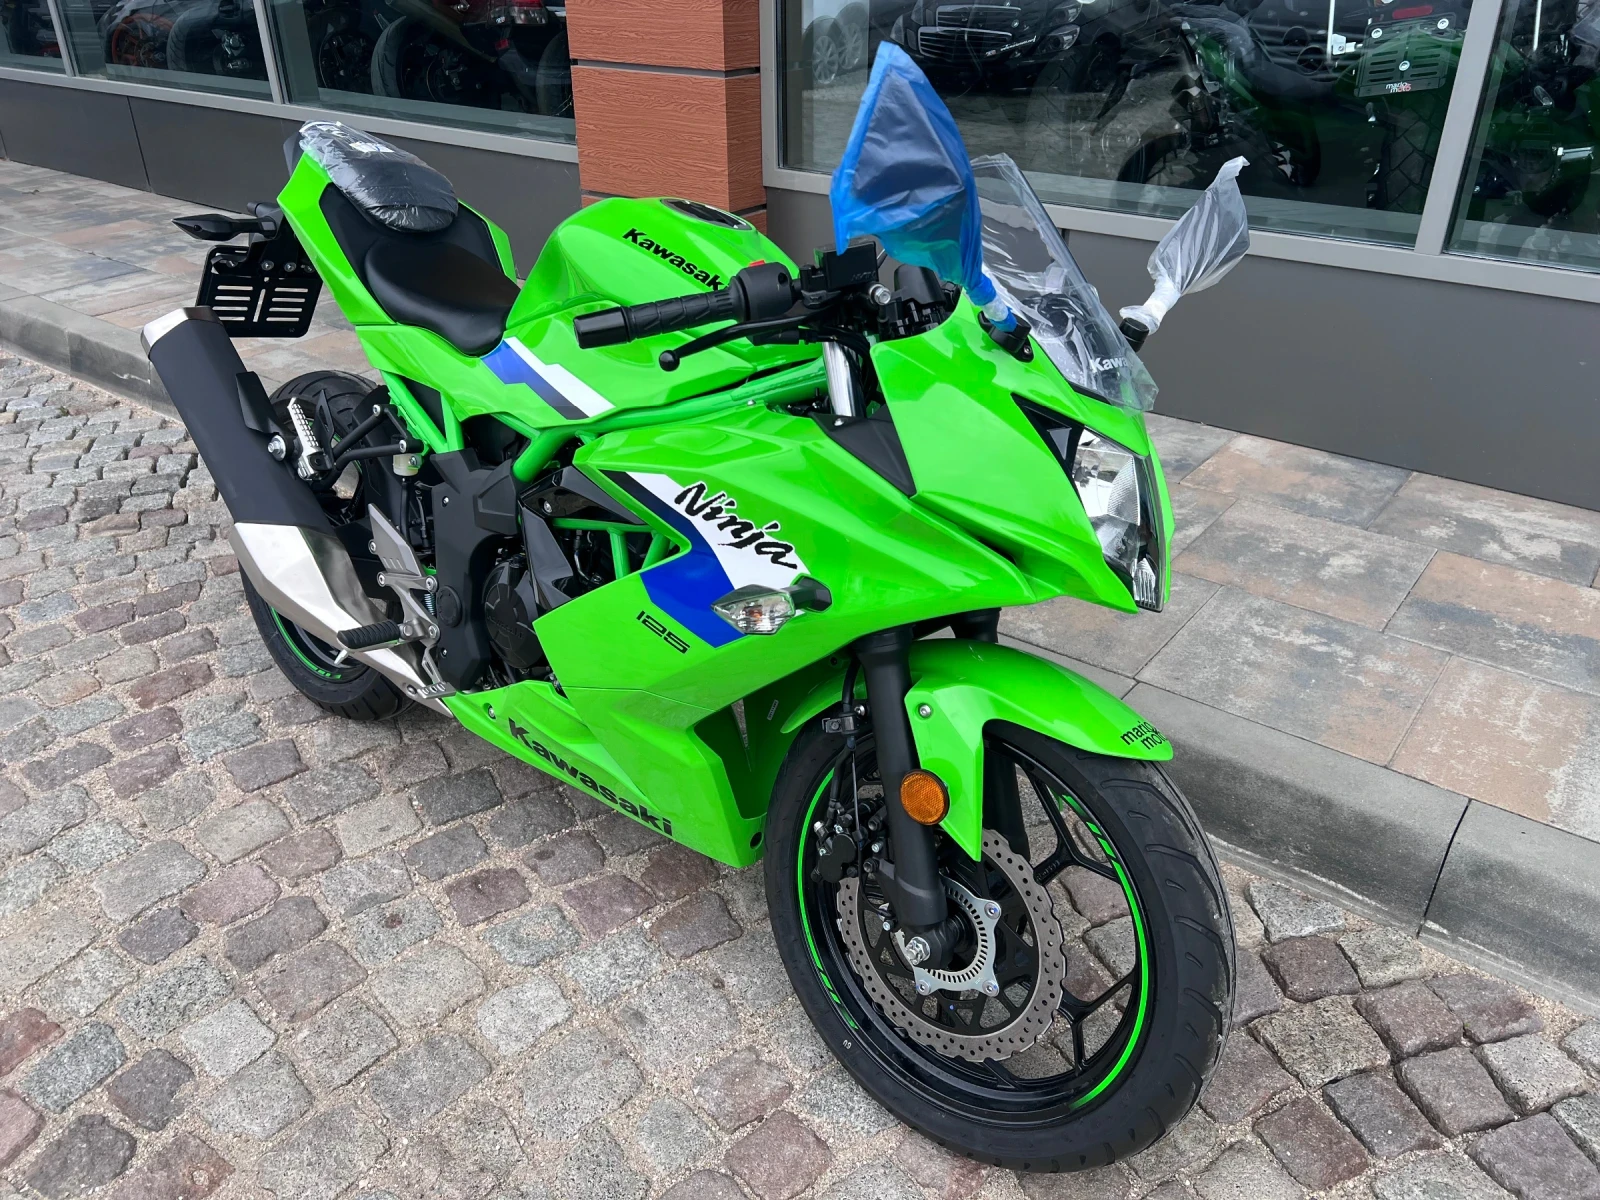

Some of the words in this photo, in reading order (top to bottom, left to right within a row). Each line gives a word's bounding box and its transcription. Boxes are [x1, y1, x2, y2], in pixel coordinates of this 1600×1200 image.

[622, 227, 728, 291] Kawasak
[1089, 357, 1128, 373] Kawa
[673, 482, 798, 570] Ninja
[636, 610, 691, 654] 125
[508, 717, 673, 837] Kawasaki
